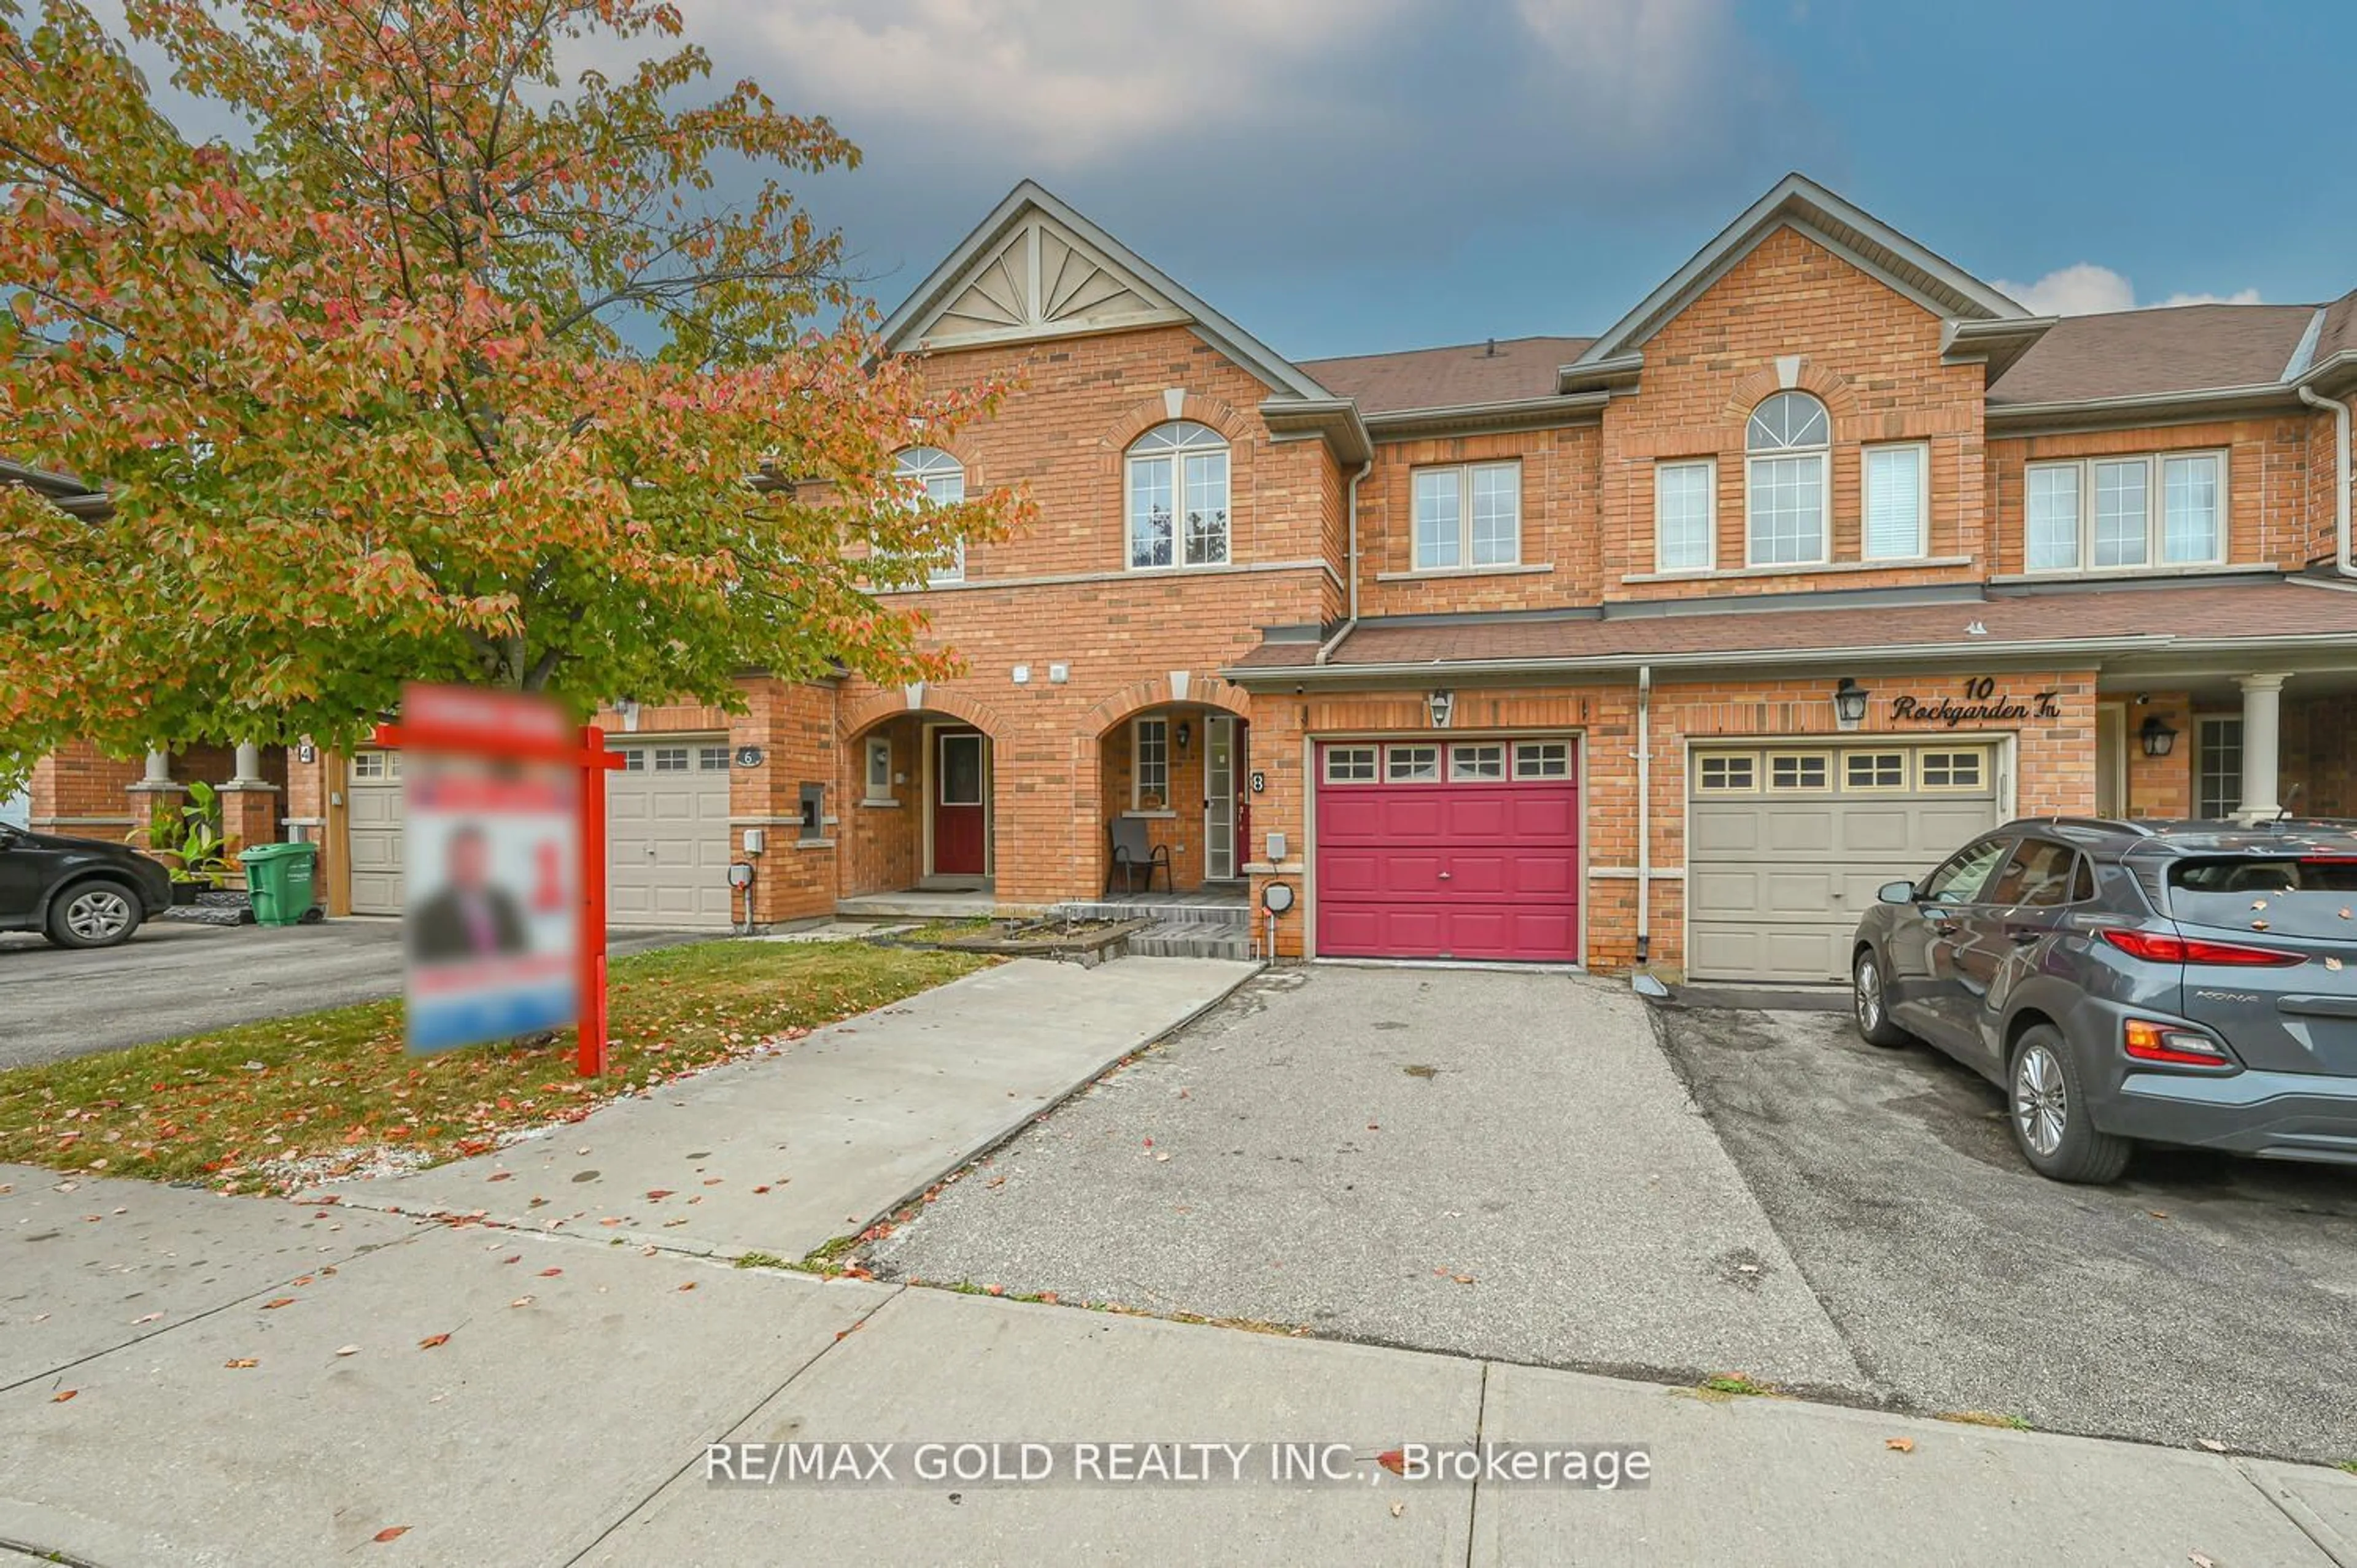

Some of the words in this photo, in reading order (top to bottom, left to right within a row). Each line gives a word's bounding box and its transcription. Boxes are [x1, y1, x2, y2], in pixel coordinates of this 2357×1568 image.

[1964, 677, 1994, 700] 10
[1891, 695, 2029, 727] Rockgarden
[745, 752, 753, 763] 6
[1253, 774, 1263, 791] 8
